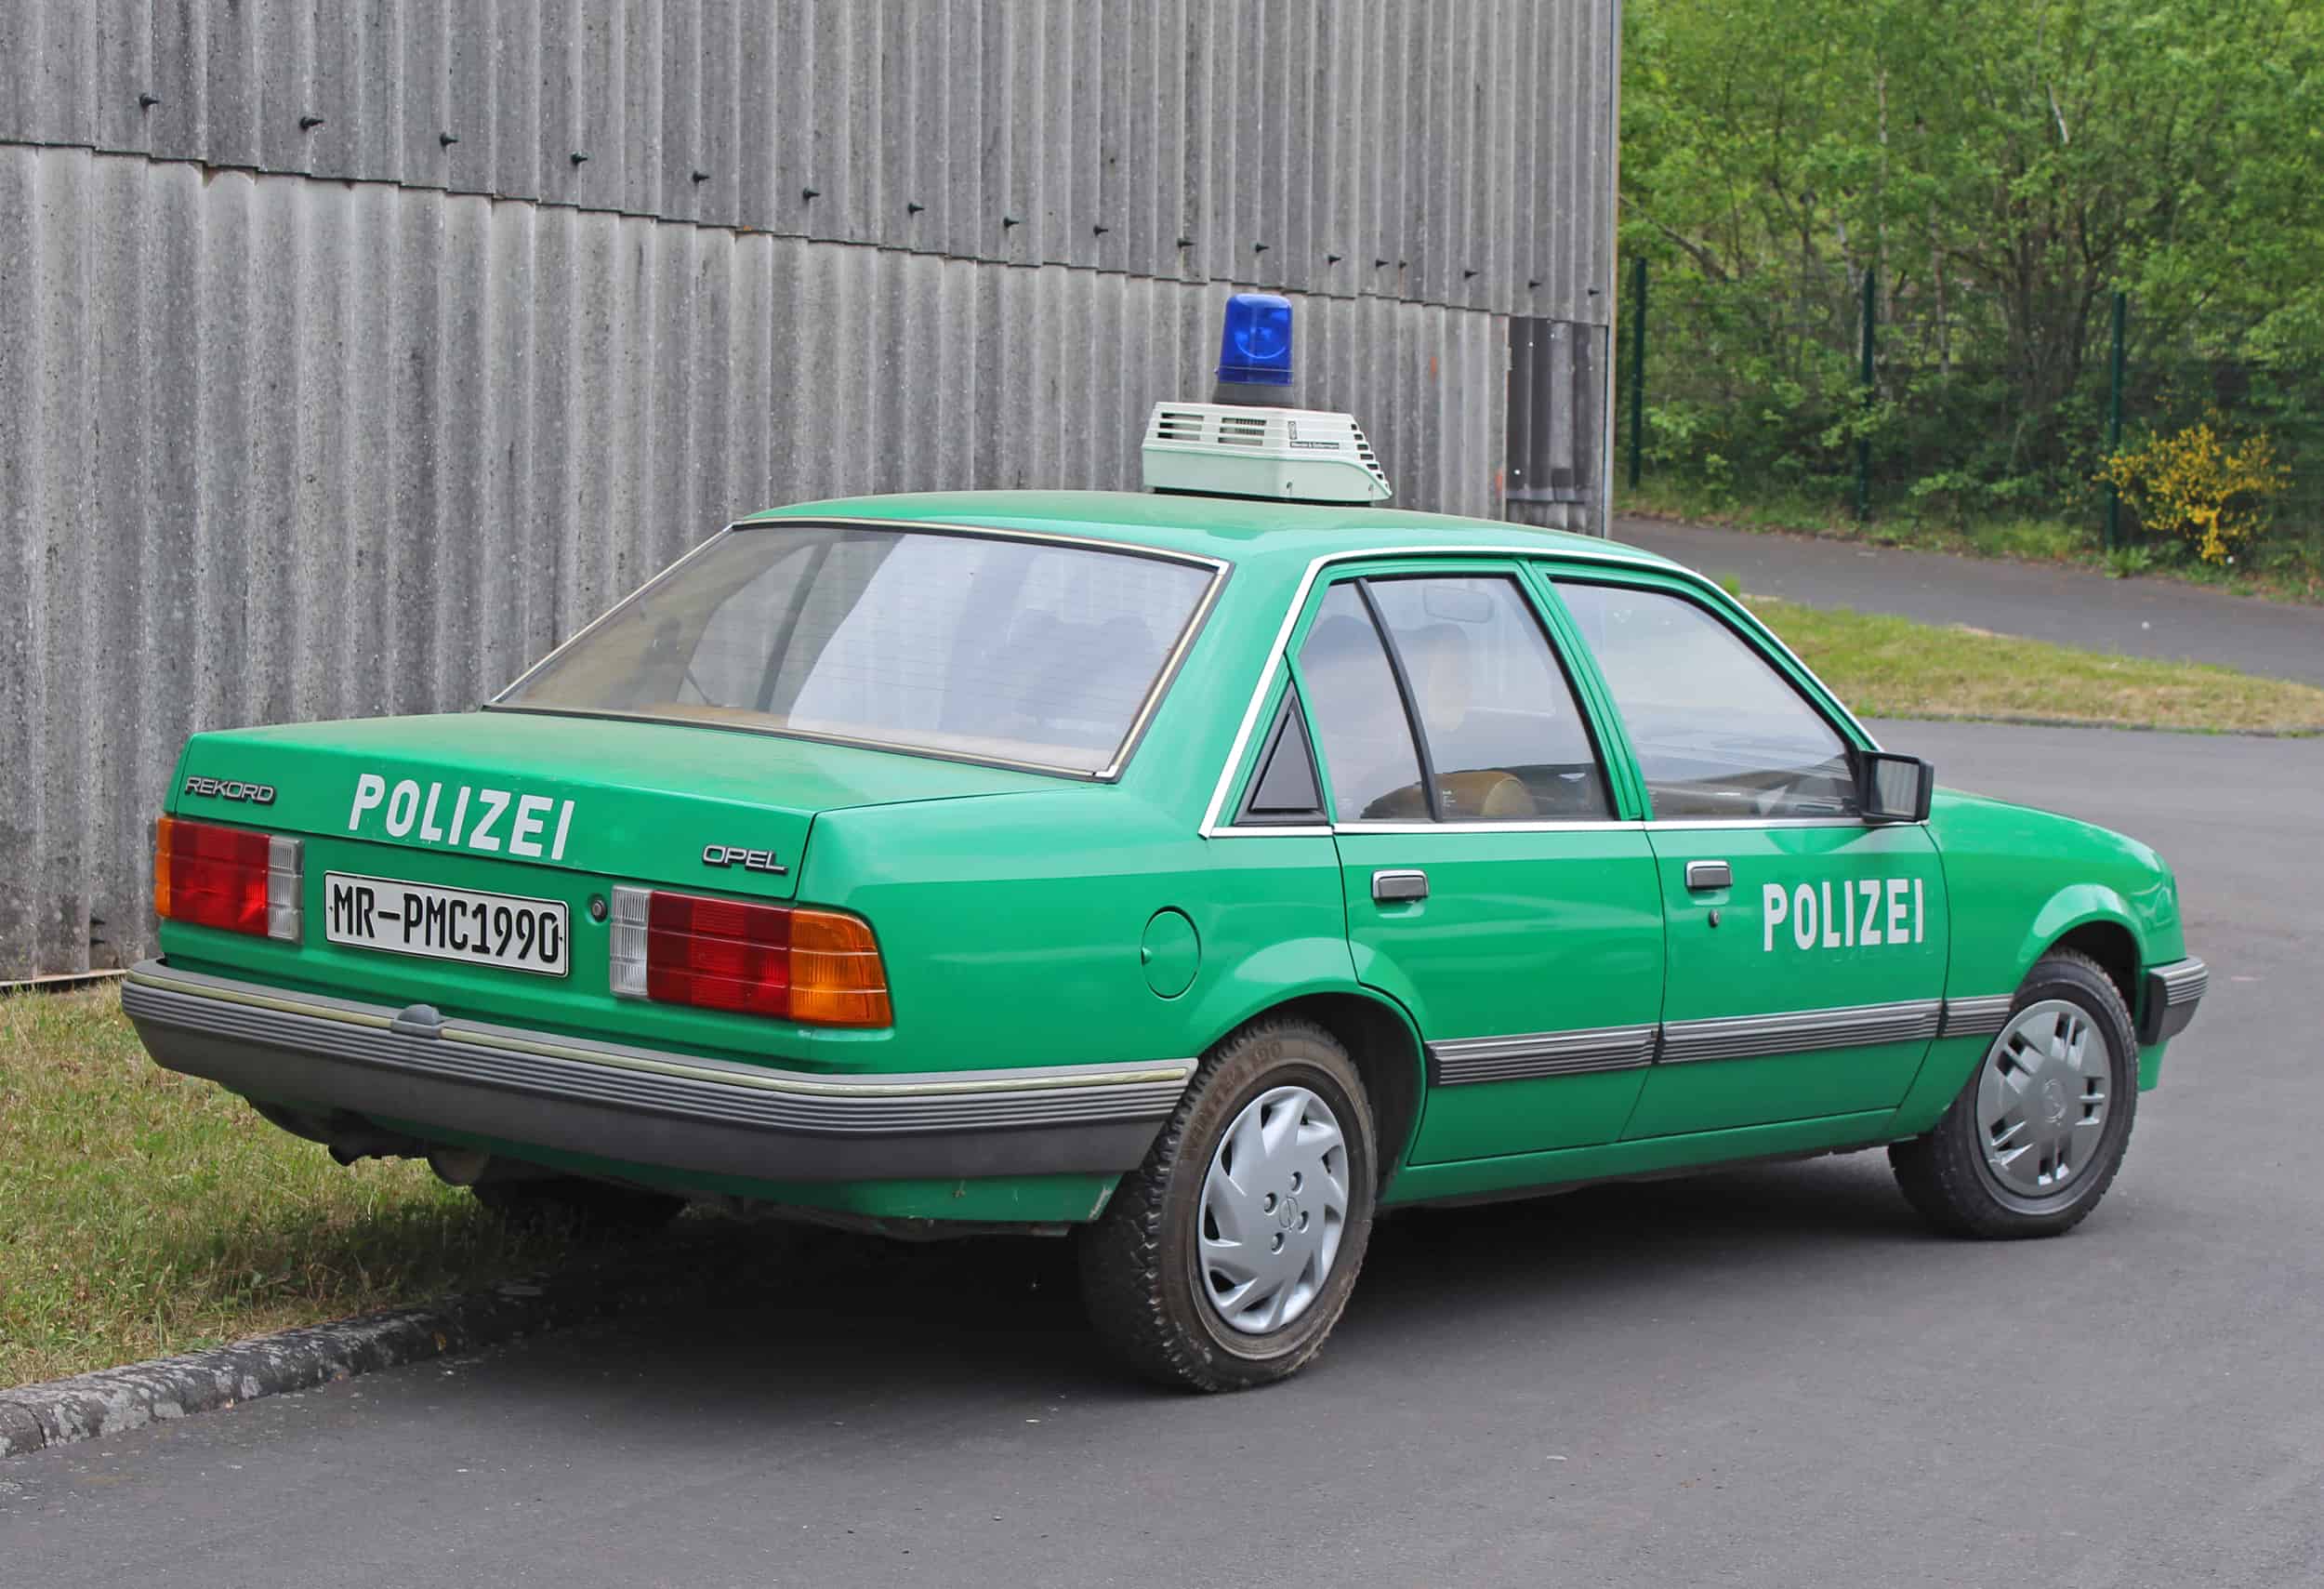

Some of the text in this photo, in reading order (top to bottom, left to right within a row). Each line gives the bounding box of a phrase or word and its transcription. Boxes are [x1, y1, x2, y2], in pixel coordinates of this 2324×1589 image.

[185, 776, 274, 801] REKORD
[349, 773, 575, 861] POLIZEI
[703, 844, 786, 871] OPEL
[334, 883, 559, 964] MR-PMC1990
[1763, 878, 1924, 951] POLIZEI
